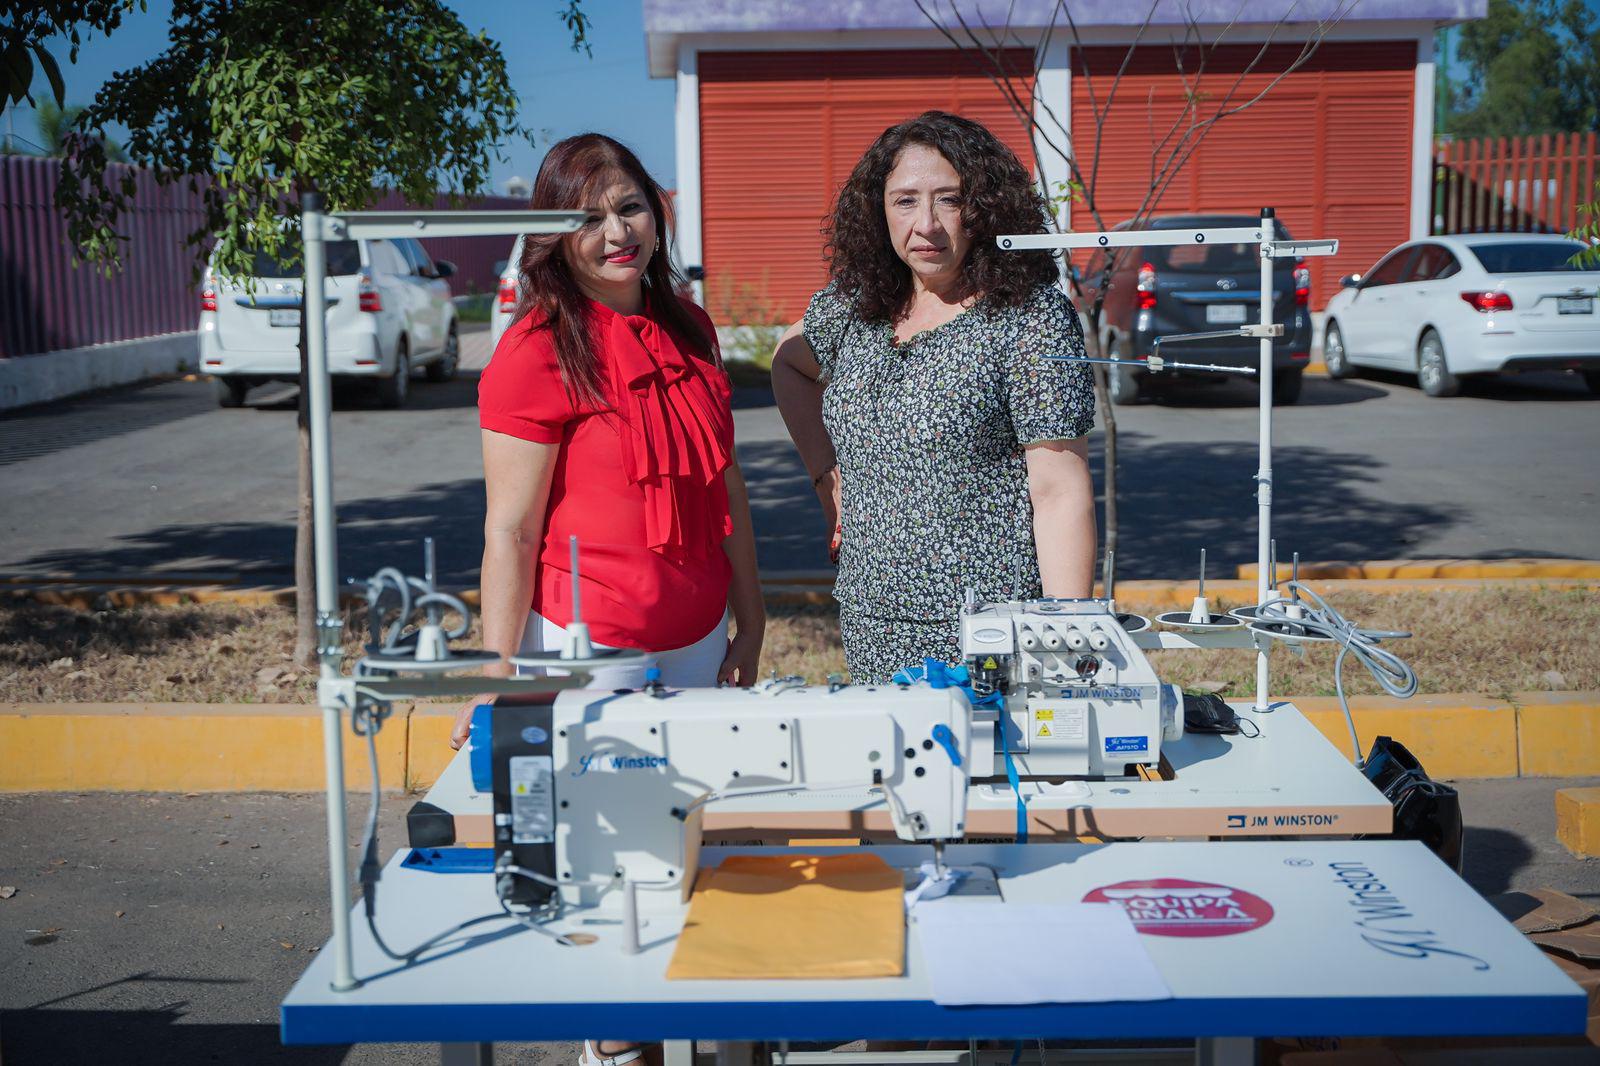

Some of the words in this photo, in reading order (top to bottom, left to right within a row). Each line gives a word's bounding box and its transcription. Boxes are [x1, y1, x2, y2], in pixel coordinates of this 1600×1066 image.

[1075, 688, 1090, 699] JM
[1092, 687, 1141, 698] WINSTON
[611, 756, 669, 770] Winston
[1251, 816, 1268, 827] JM
[1328, 861, 1414, 922] Winston
